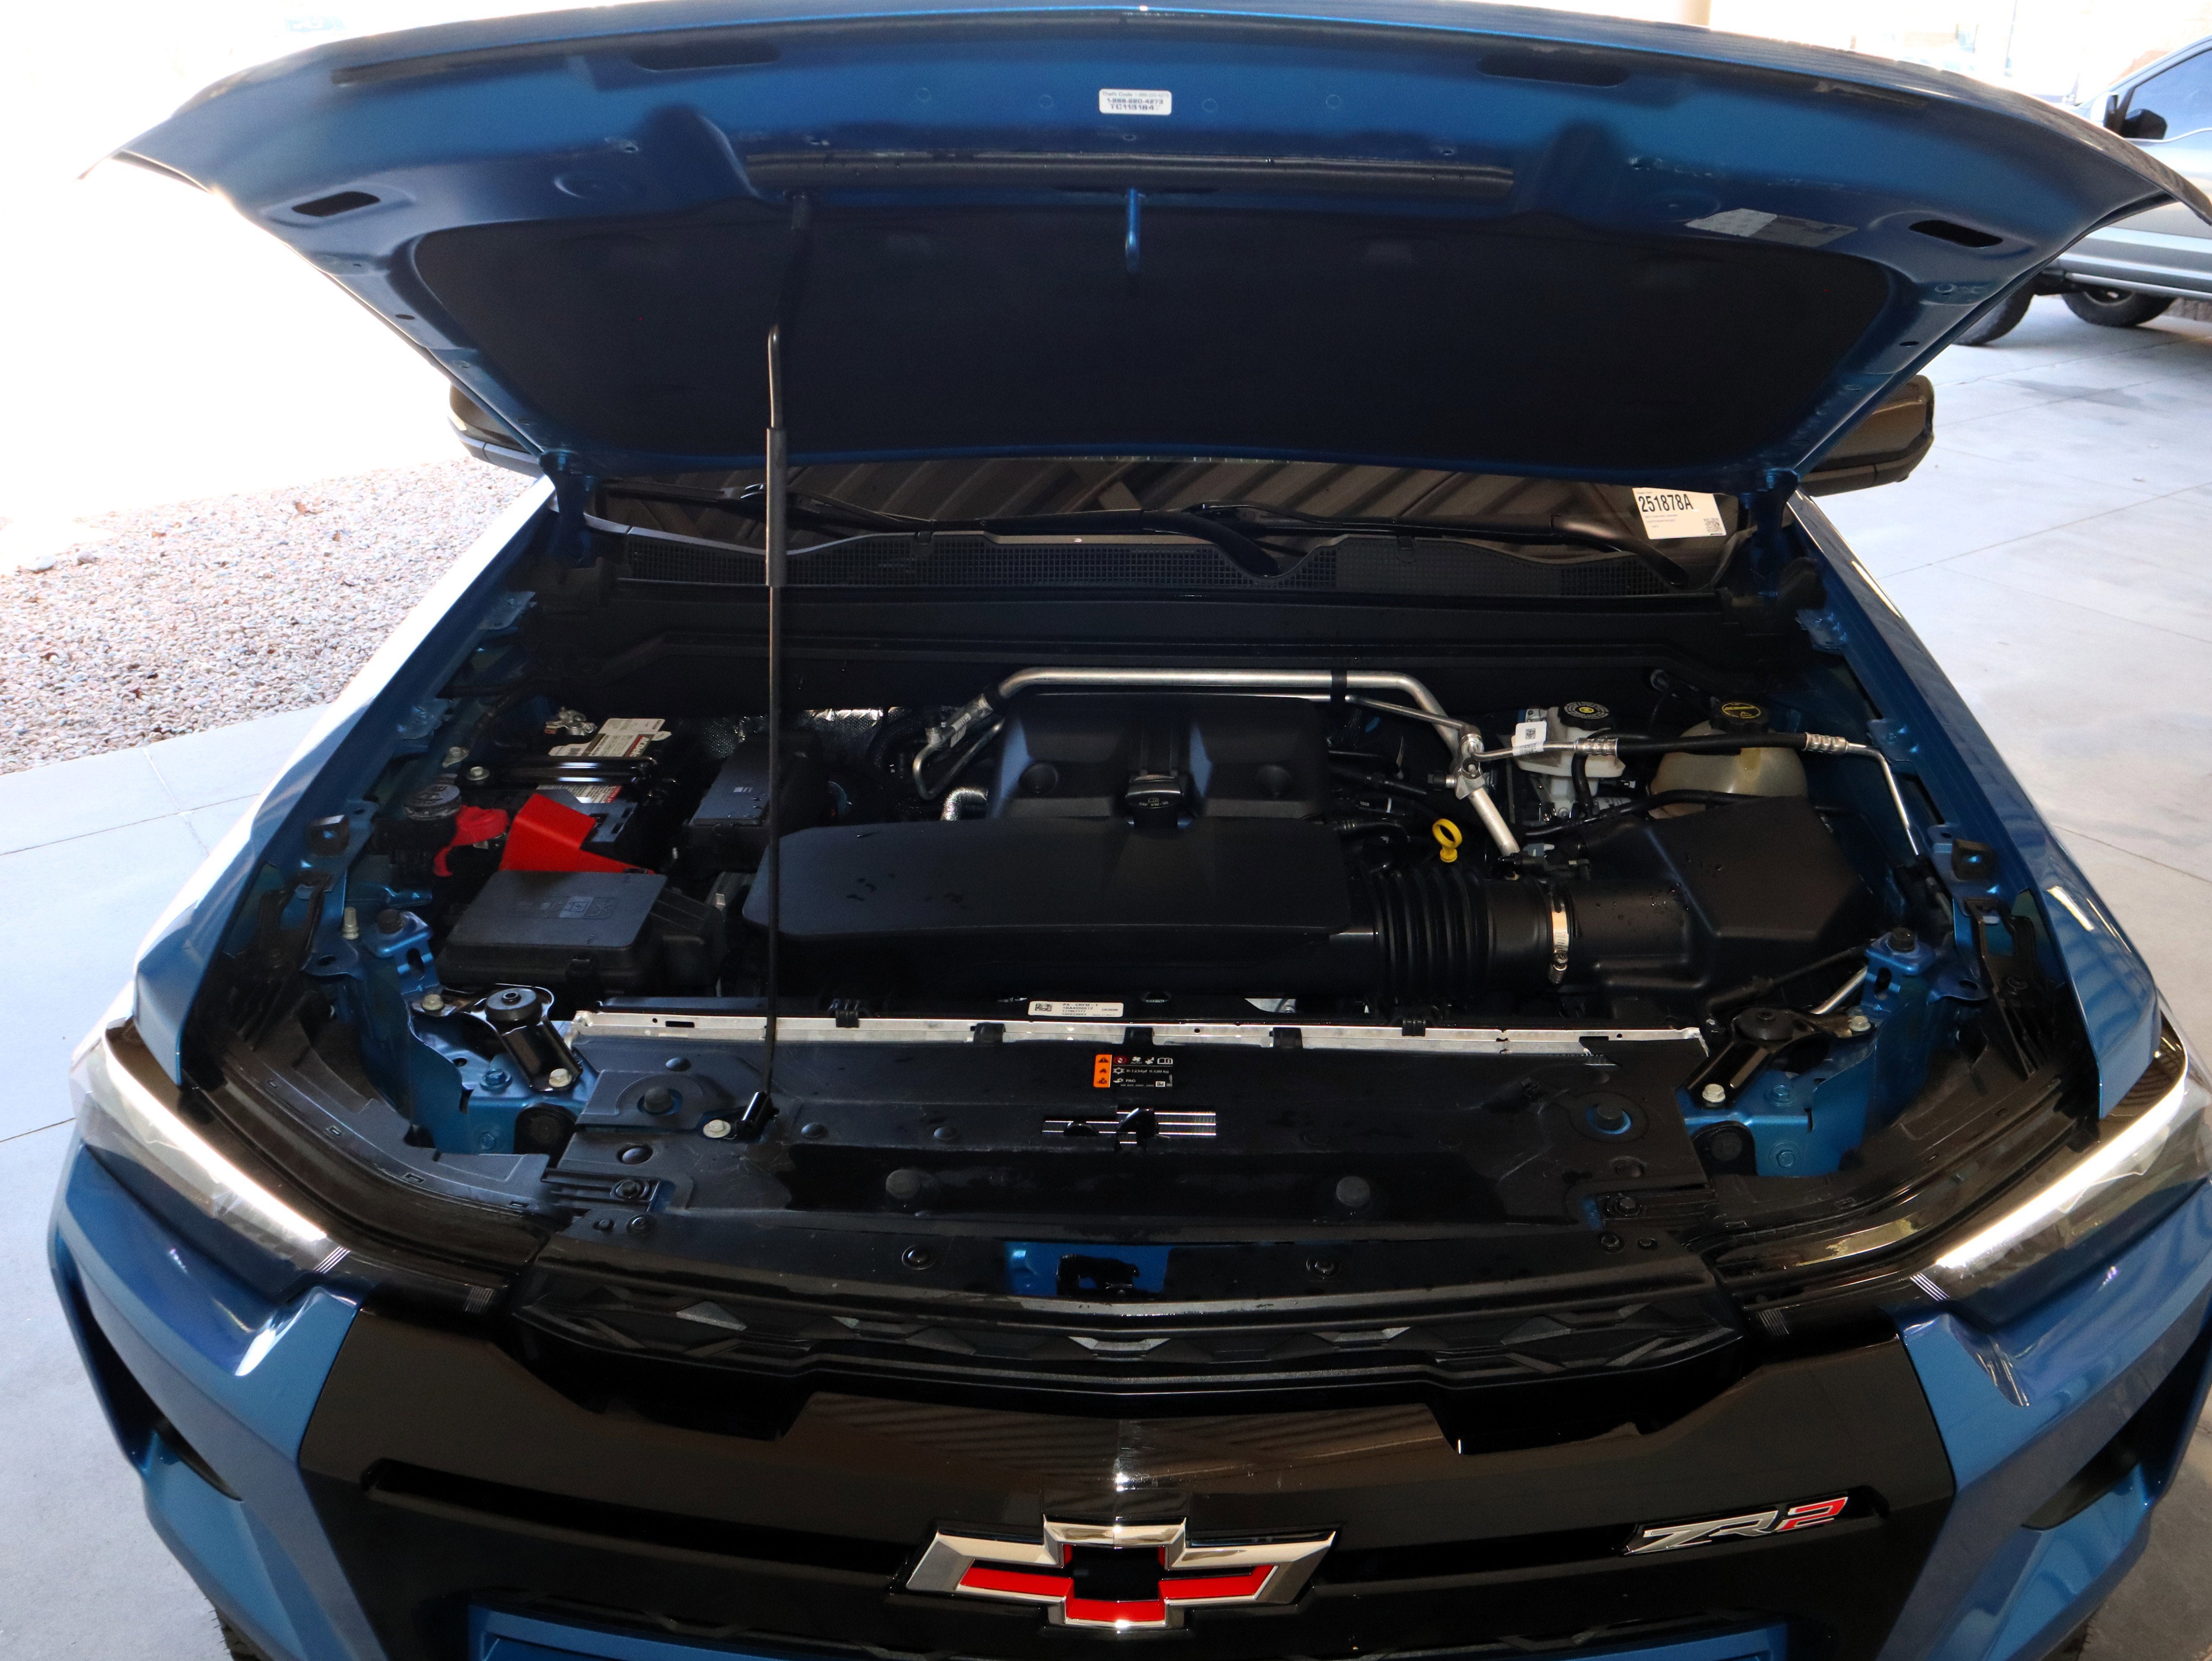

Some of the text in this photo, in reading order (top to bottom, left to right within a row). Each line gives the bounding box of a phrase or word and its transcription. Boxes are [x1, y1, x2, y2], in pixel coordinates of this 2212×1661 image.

[1638, 494, 1694, 512] 251878A
[629, 736, 650, 757] ACDelc
[1624, 1496, 1848, 1556] ZR2
